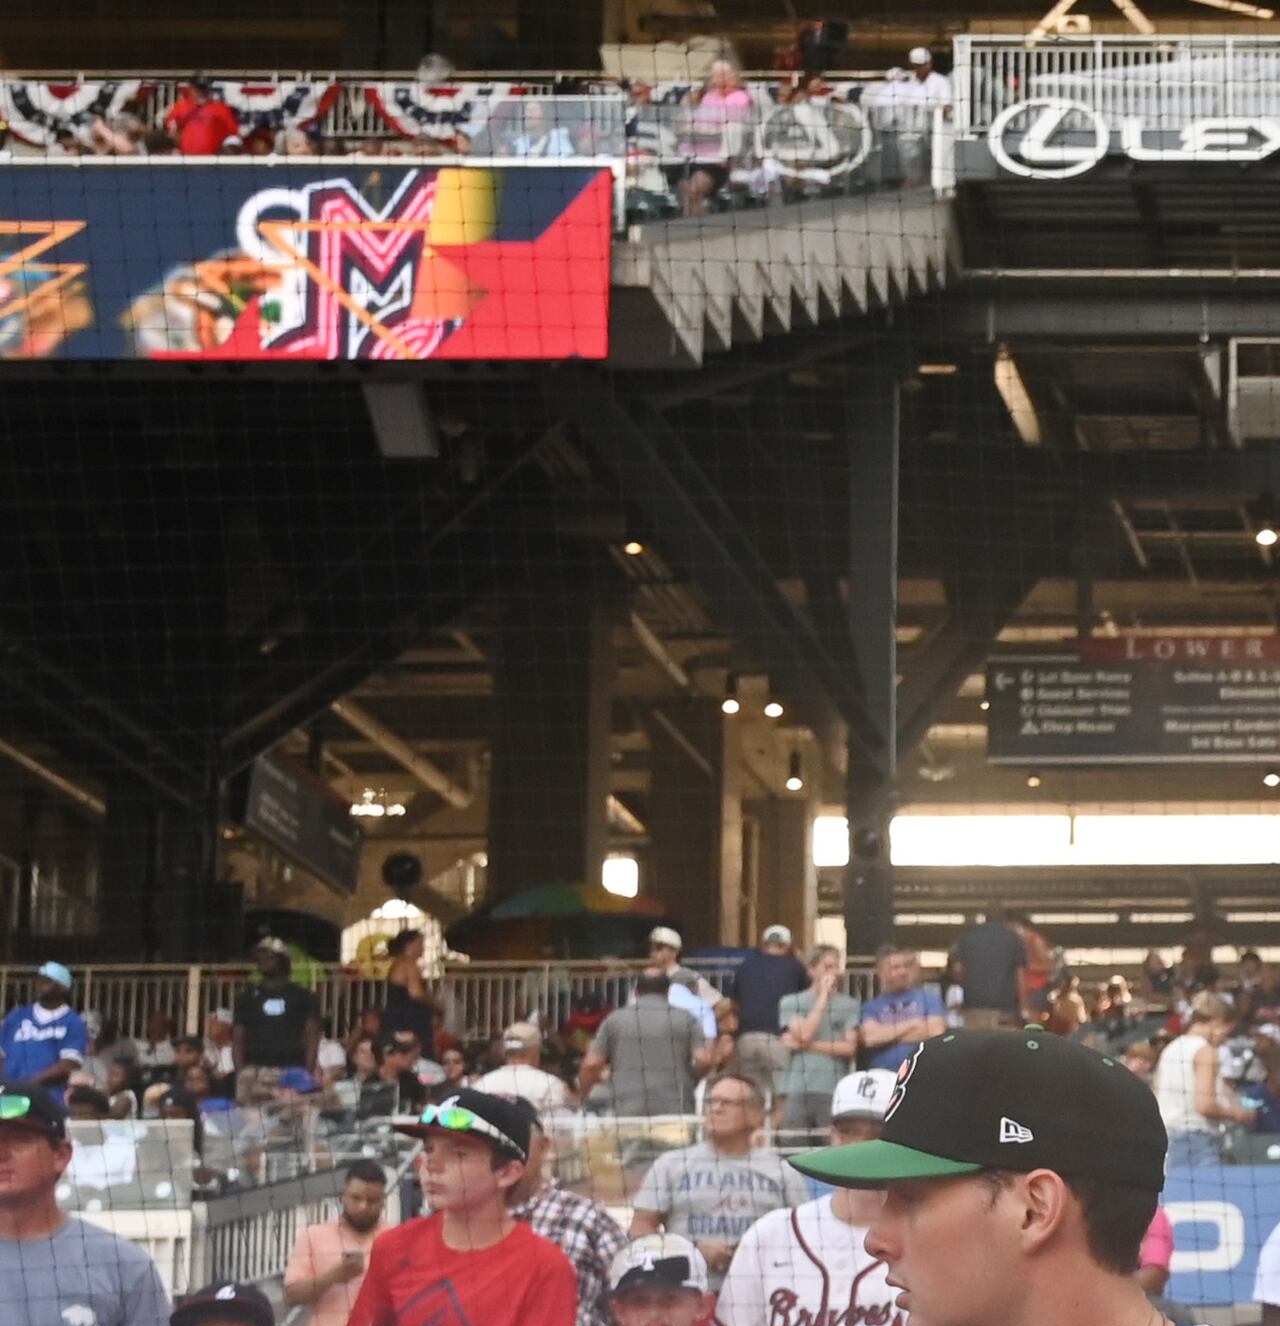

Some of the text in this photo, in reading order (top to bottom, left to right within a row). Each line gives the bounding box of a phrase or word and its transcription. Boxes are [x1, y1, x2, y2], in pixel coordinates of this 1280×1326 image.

[1126, 636, 1264, 660] LOWER
[679, 1171, 781, 1193] ATLANTA
[688, 1213, 753, 1237] BRAV
